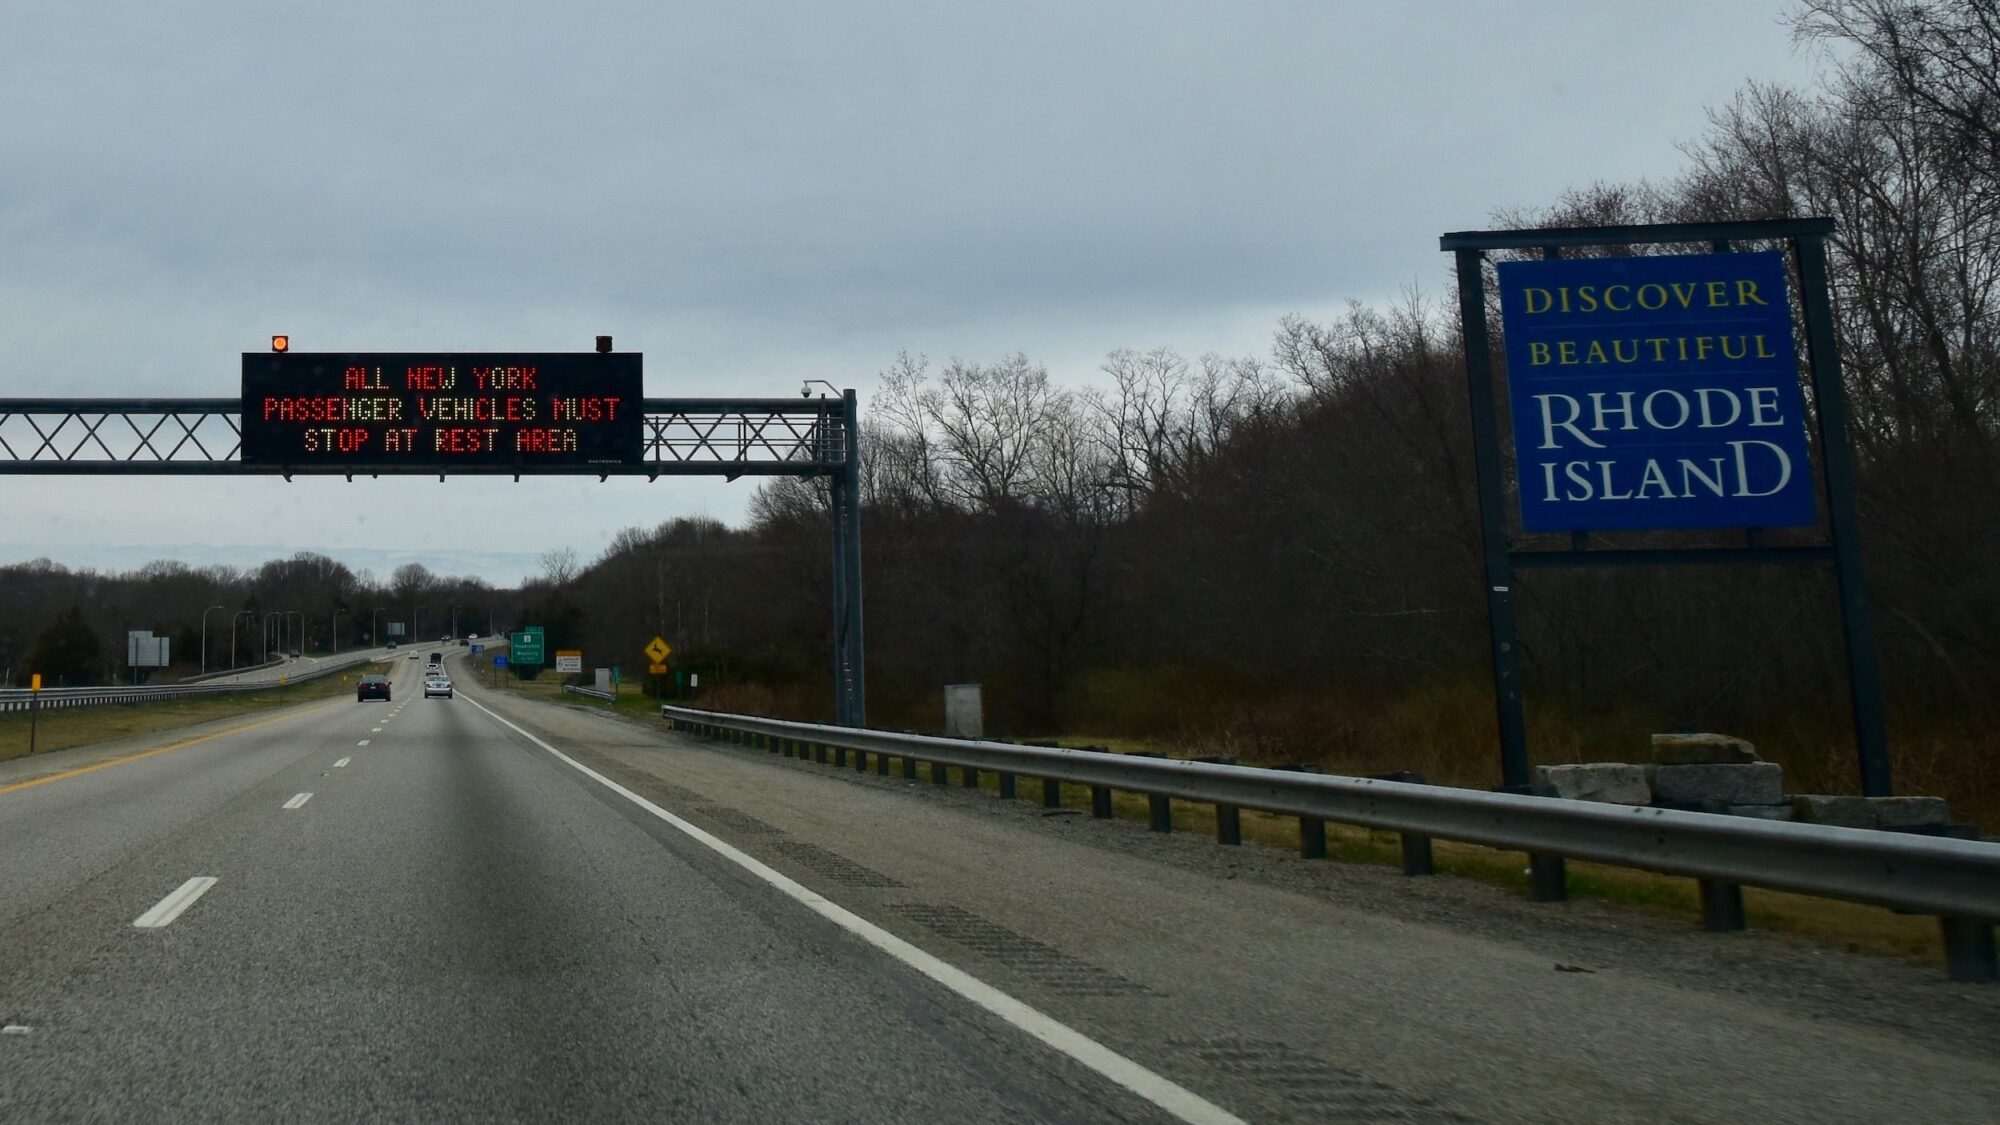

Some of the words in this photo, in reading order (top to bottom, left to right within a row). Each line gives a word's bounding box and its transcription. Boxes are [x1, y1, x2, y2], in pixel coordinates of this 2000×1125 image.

[1523, 280, 1768, 314] DISCOVER
[1529, 335, 1776, 366] BEAUTIFUL
[346, 367, 390, 390] ALL
[408, 367, 455, 390] NEW
[474, 367, 536, 390] YORK
[264, 397, 403, 421] PASSENGER
[420, 397, 536, 421] VEHICLES
[554, 397, 620, 421] MUST
[1532, 387, 1785, 449] RHODE
[305, 428, 368, 452] STOP
[386, 428, 418, 452] AT
[435, 428, 499, 452] REST
[517, 428, 577, 452] AREA
[1540, 440, 1792, 501] ISLAND
